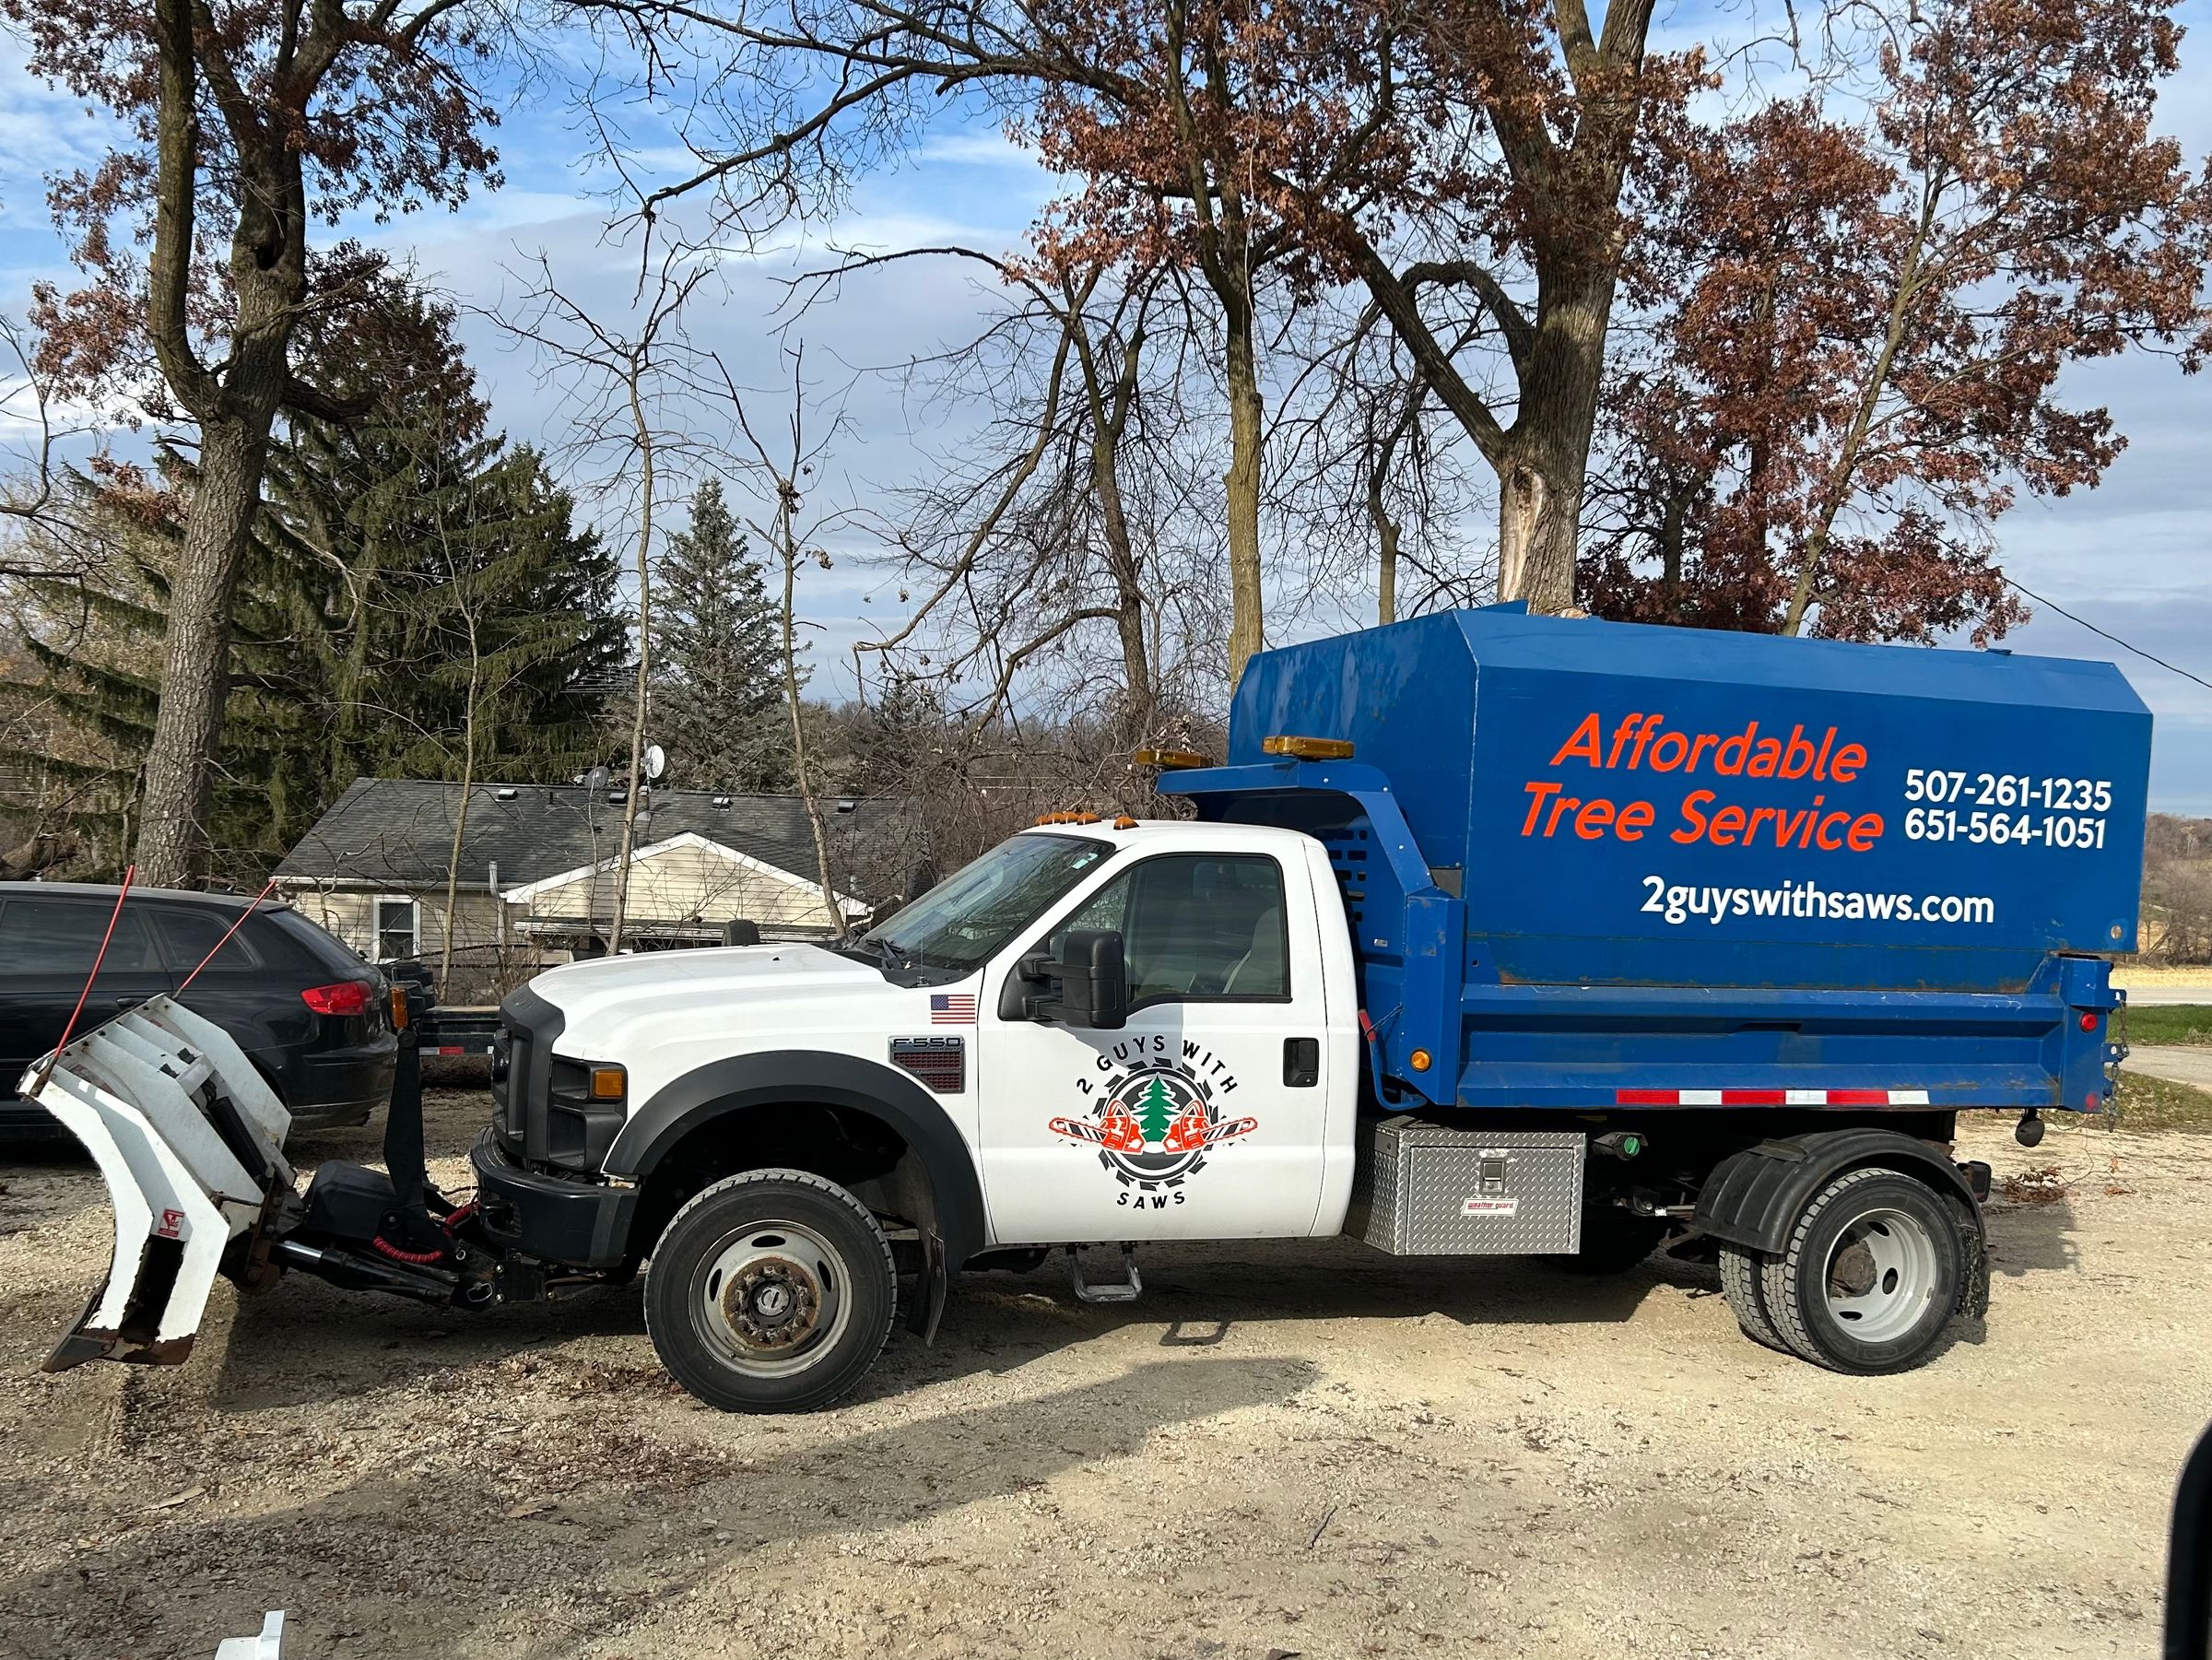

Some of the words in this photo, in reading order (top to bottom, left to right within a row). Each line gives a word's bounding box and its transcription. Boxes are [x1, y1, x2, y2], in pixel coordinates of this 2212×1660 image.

[1550, 712, 1867, 783] Affordable
[1904, 769, 2112, 812] 507-261-1235
[1522, 782, 1655, 842] Tree
[1670, 789, 1885, 852] Service
[1904, 807, 2106, 849] 651-564-1051
[1640, 875, 1994, 924] 2guyswithsaws.com
[1076, 1077, 1094, 1095] 2
[1096, 1034, 1165, 1072] GUYS
[1182, 1039, 1238, 1094] WITH
[1116, 1191, 1185, 1209] SAWS
